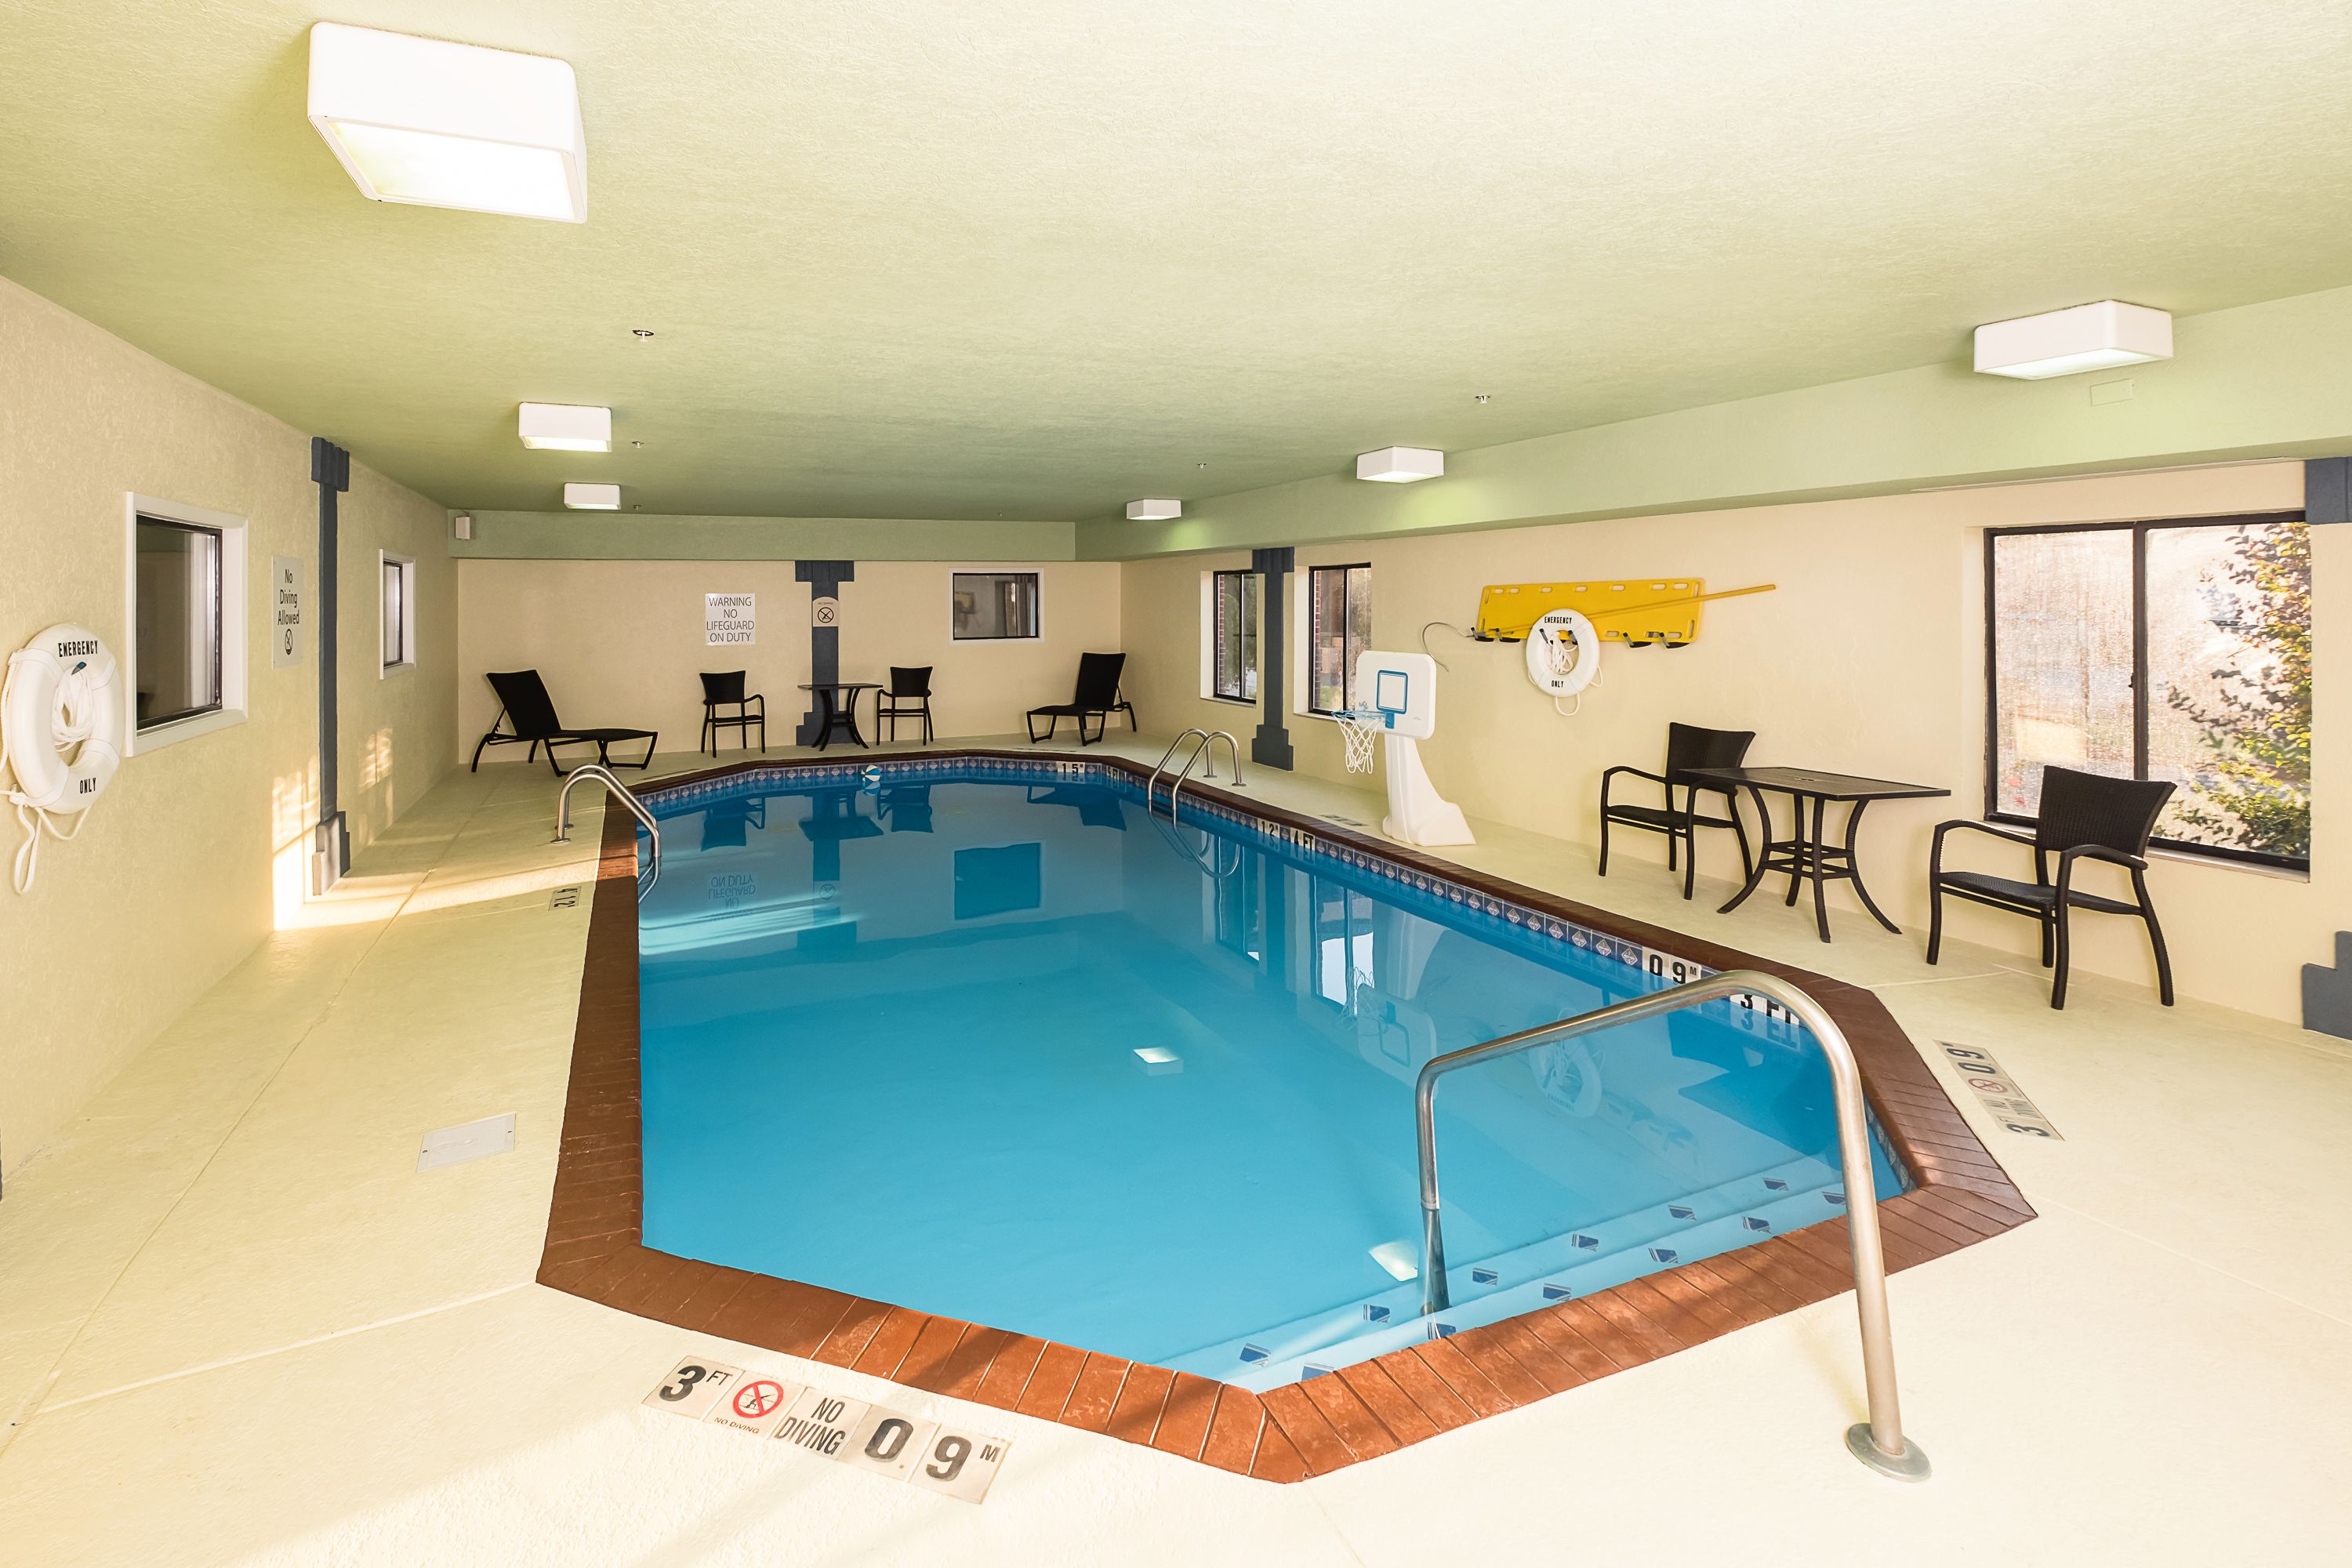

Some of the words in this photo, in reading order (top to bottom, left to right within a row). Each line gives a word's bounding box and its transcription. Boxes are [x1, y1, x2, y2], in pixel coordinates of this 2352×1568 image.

[285, 568, 293, 584] No
[279, 589, 298, 608] Diving
[709, 597, 752, 607] WARNING
[278, 609, 299, 626] Allowed
[724, 608, 738, 619] NO
[706, 620, 755, 631] LIFEGUARD
[710, 633, 724, 643] ON
[727, 632, 751, 642] DUTY
[58, 640, 99, 658] EMERGENCY
[1551, 680, 1564, 688] ONLY
[79, 777, 96, 794] ONLY
[2005, 1123, 2050, 1137] 3
[659, 1365, 706, 1402] 3
[706, 1370, 734, 1385] FT
[810, 1397, 846, 1424] NO
[714, 1417, 728, 1425] NO
[729, 1421, 760, 1434] DIVING
[774, 1416, 846, 1455] DIVING
[979, 1444, 1001, 1463] M
